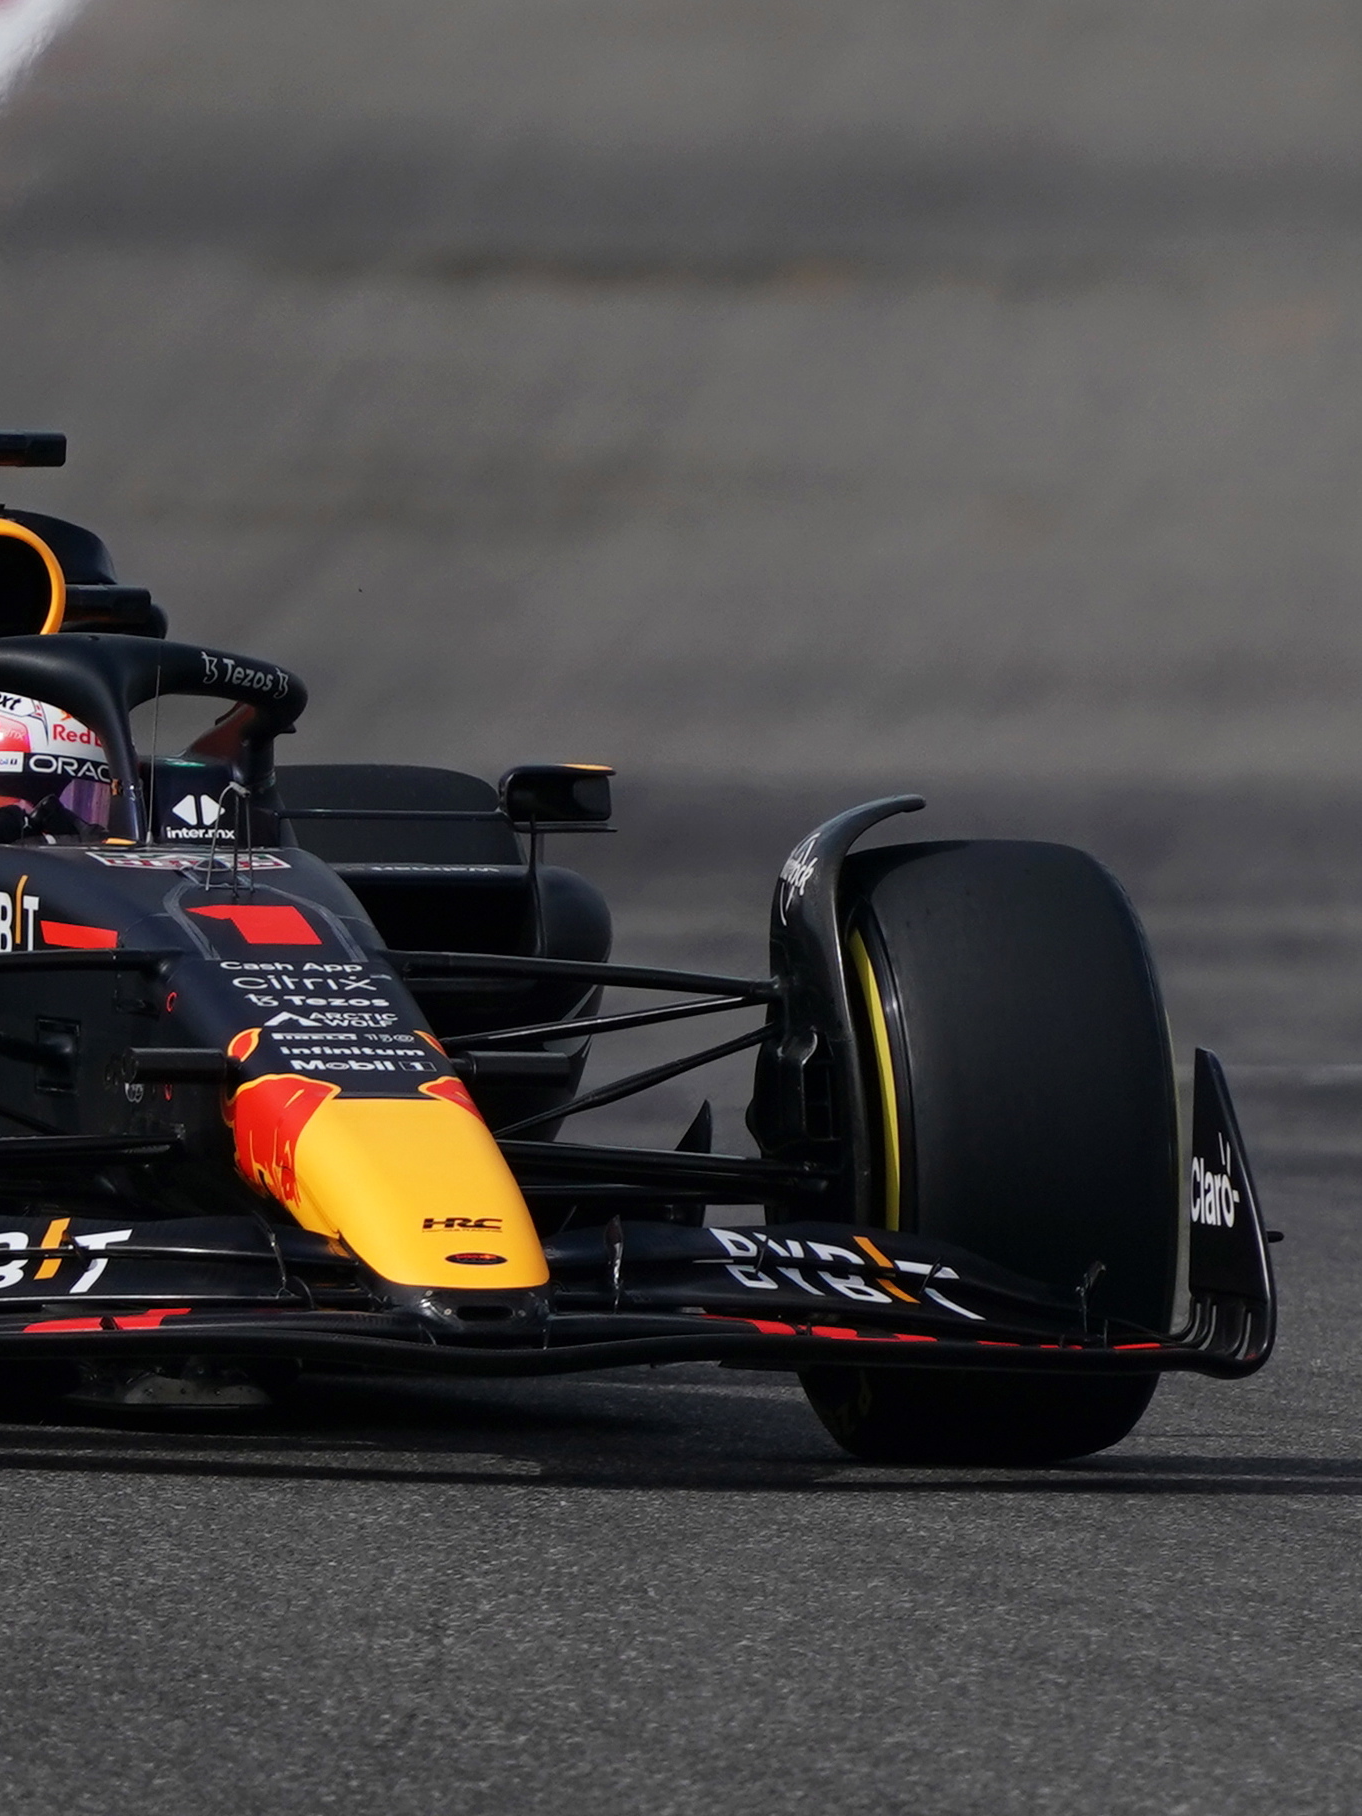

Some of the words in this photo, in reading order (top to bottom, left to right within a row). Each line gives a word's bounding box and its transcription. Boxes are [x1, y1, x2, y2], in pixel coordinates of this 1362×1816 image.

[222, 657, 274, 692] Tezos
[53, 723, 91, 745] Red
[166, 827, 235, 840] inter.mx
[185, 904, 324, 945] 1
[220, 961, 294, 972] Cash
[302, 962, 363, 973] App
[232, 974, 377, 991] Citrix
[284, 995, 390, 1007] Tezos
[309, 1012, 399, 1021] ARCTIC
[323, 1019, 393, 1028] WOLF
[290, 1059, 396, 1071] Mobil
[1190, 1155, 1236, 1228] Claro
[422, 1217, 503, 1230] HRC
[708, 1227, 987, 1321] BYBIT
